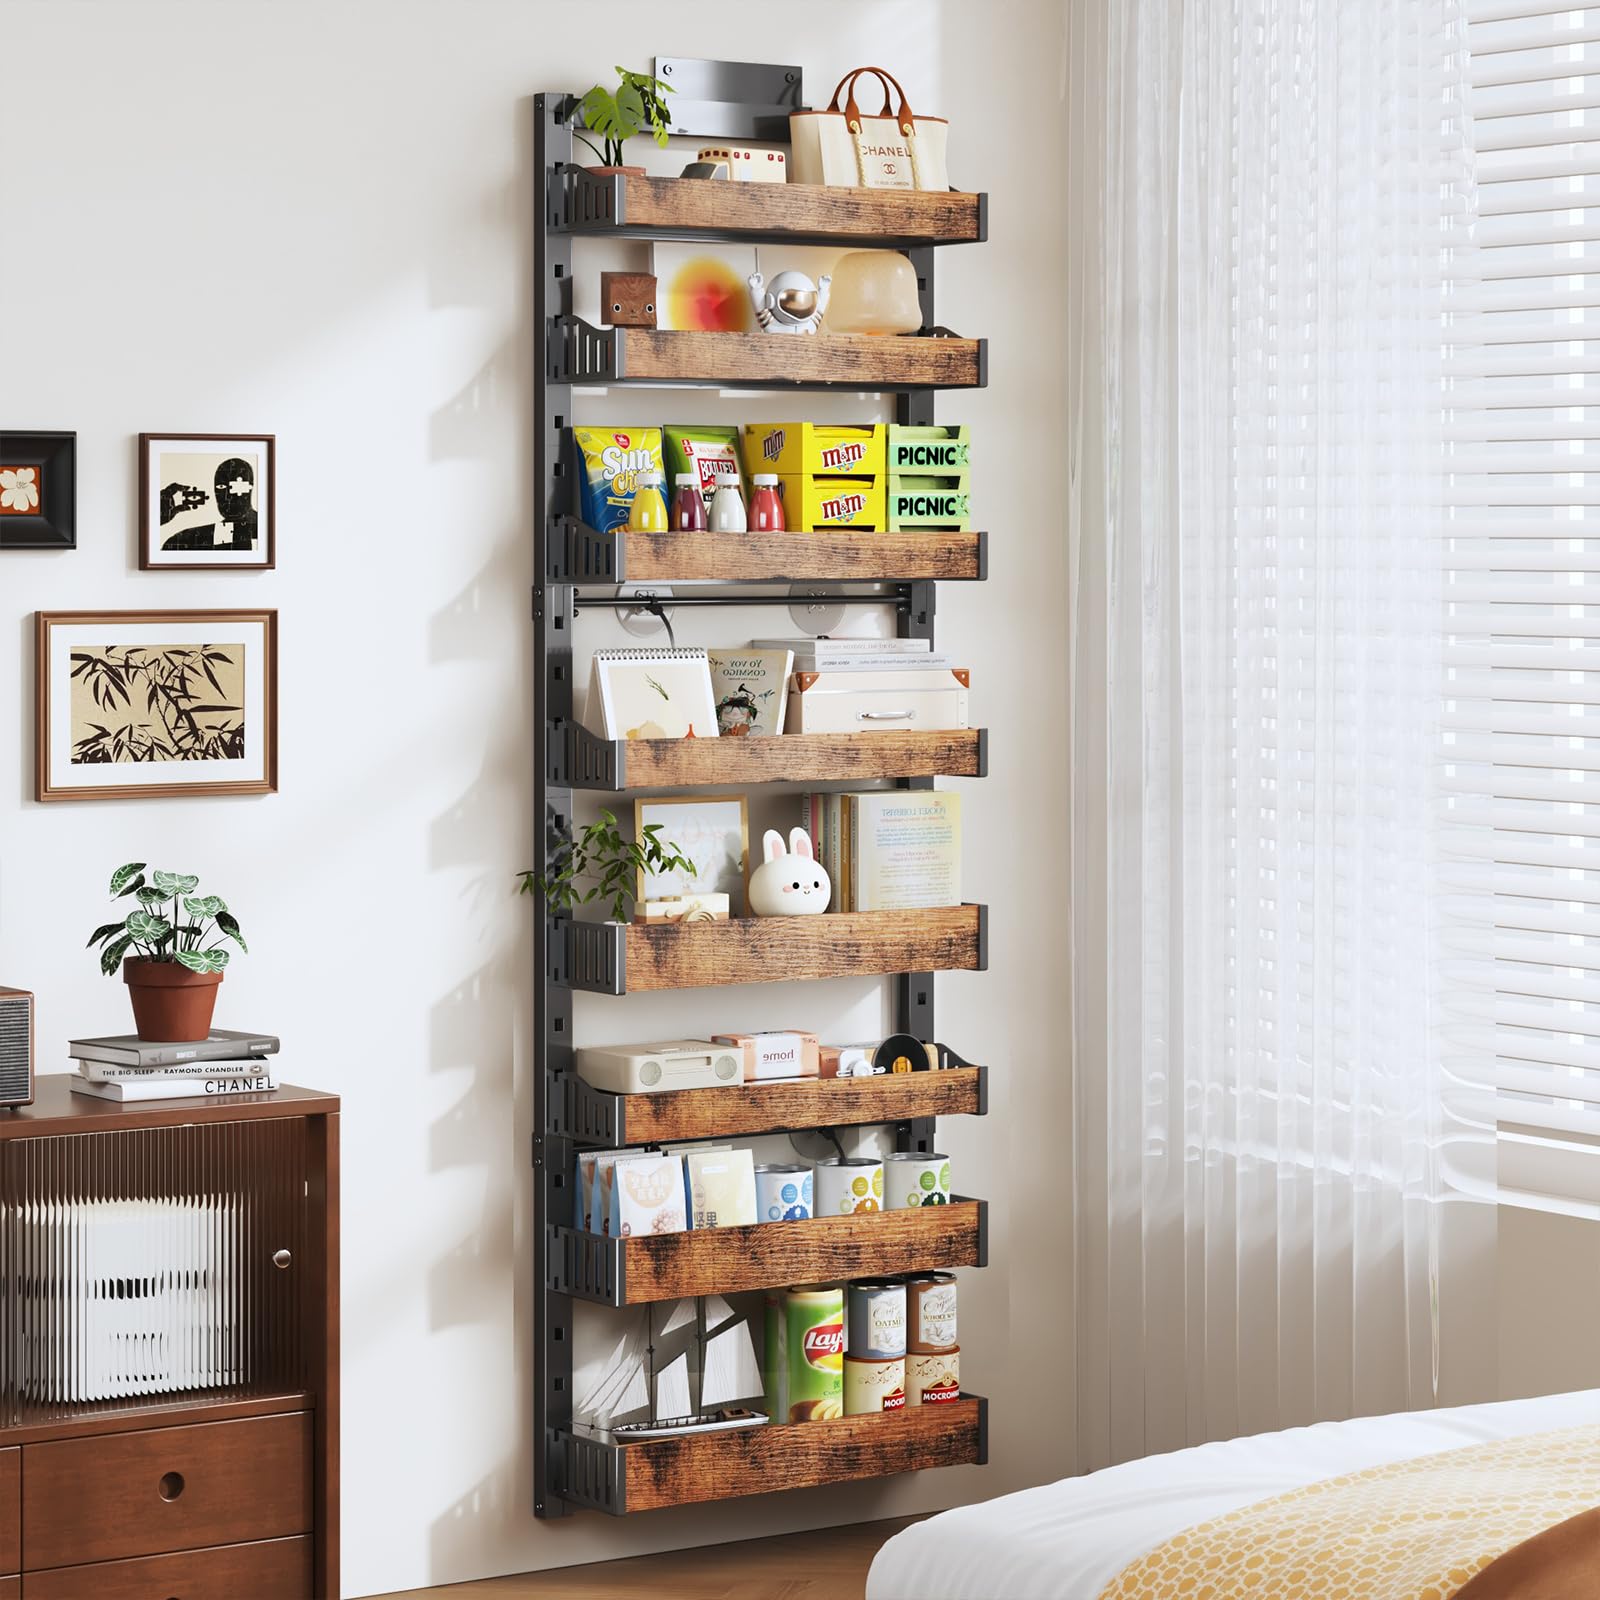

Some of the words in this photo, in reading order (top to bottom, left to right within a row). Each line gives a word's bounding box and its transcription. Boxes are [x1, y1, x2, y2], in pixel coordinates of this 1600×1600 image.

[601, 446, 655, 480] Sun
[898, 446, 957, 465] PICNIC
[898, 497, 957, 516] PICNIC
[204, 1076, 275, 1094] CHANEL
